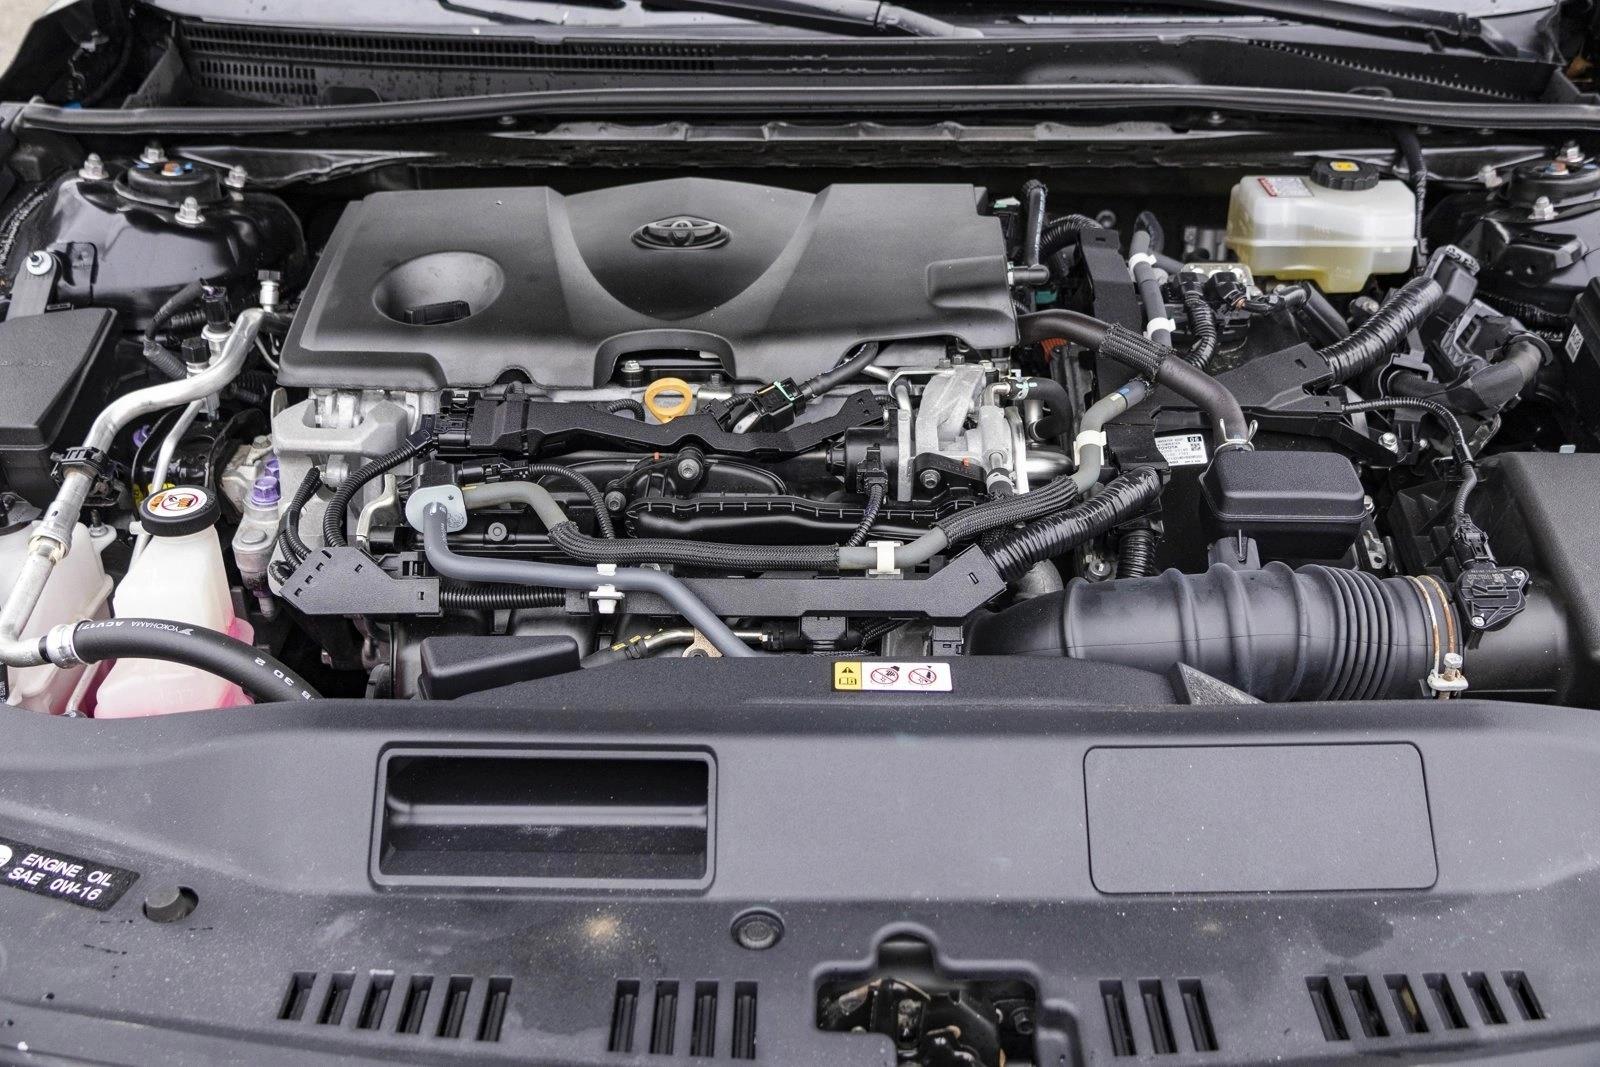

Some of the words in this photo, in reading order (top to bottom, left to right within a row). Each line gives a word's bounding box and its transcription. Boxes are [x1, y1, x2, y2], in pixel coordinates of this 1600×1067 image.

[131, 621, 179, 632] YOKOHAMA
[8, 867, 46, 885] SAE
[49, 878, 103, 901] 0W-16
[21, 853, 84, 878] ENGINE
[87, 870, 113, 887] OIL
